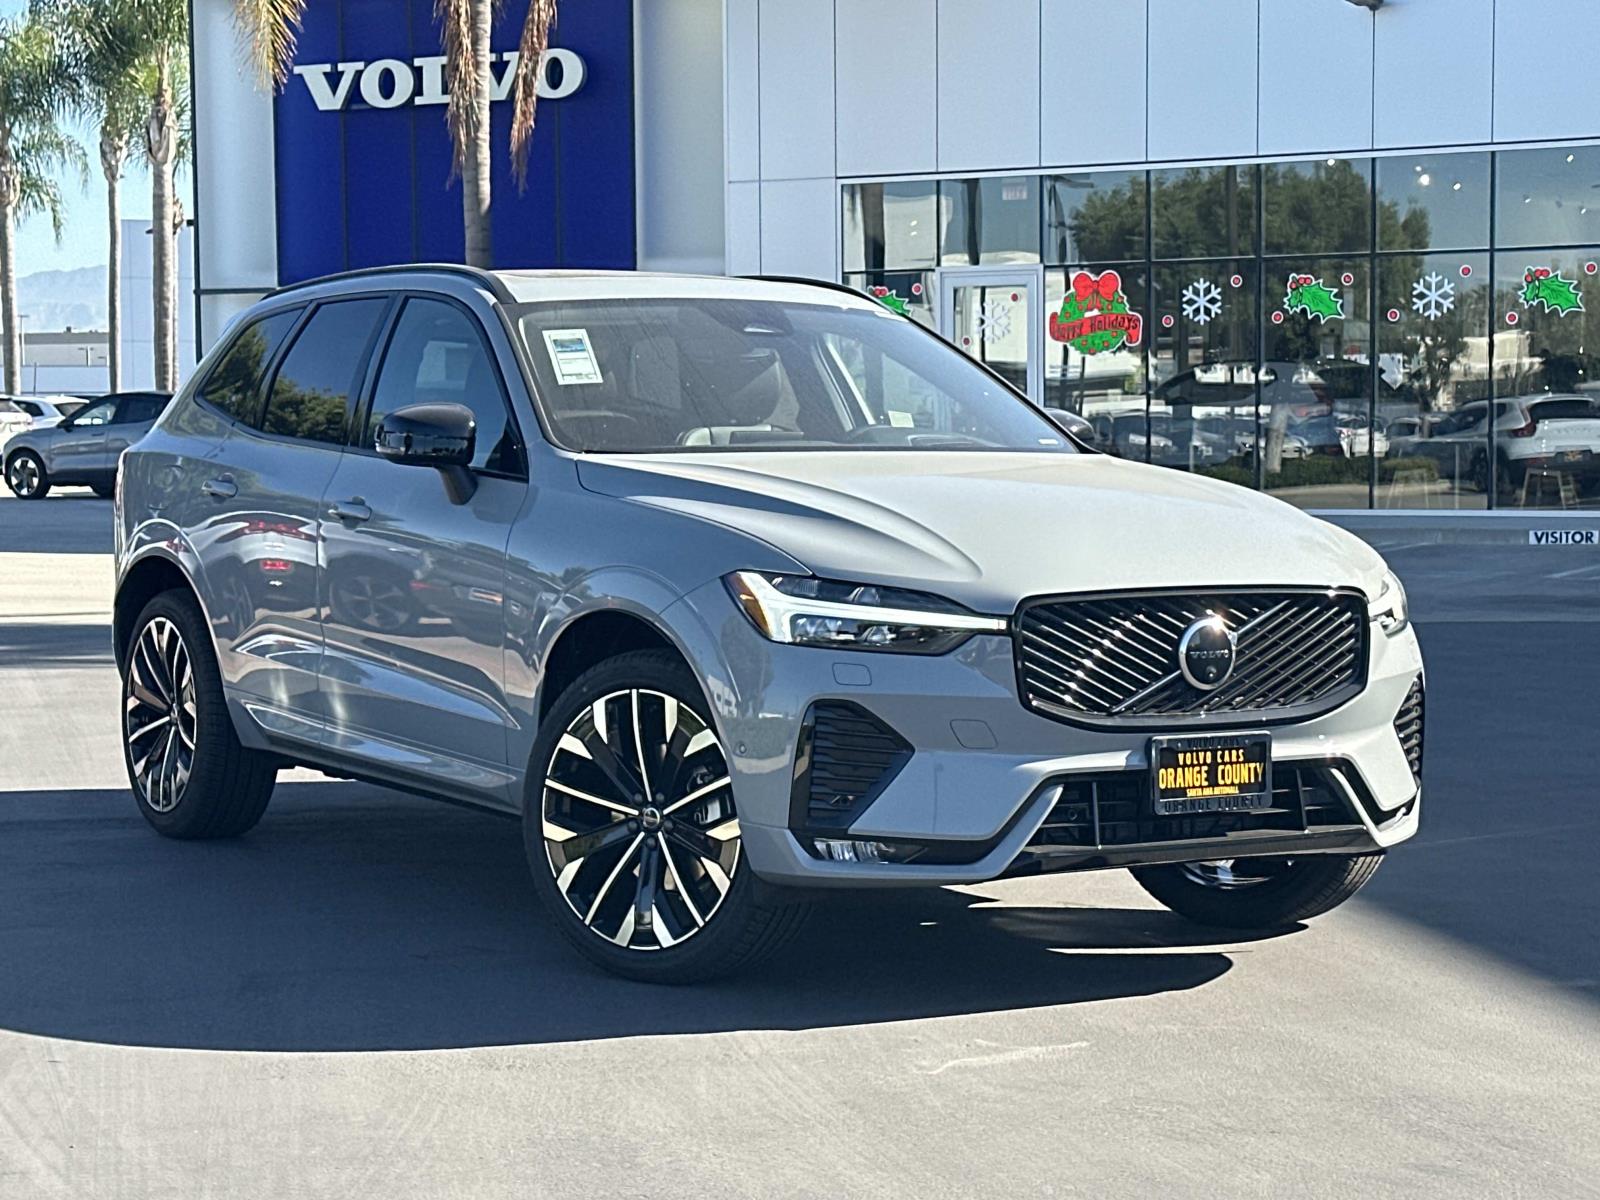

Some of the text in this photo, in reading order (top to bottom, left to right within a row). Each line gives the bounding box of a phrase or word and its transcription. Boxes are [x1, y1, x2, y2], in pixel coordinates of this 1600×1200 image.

[293, 48, 584, 111] VOLVO
[1534, 531, 1594, 544] VISITOR
[1190, 649, 1229, 658] VOLVO
[1178, 749, 1244, 766] VOLVO CARS
[1159, 762, 1264, 789] ORANGE COUNTY
